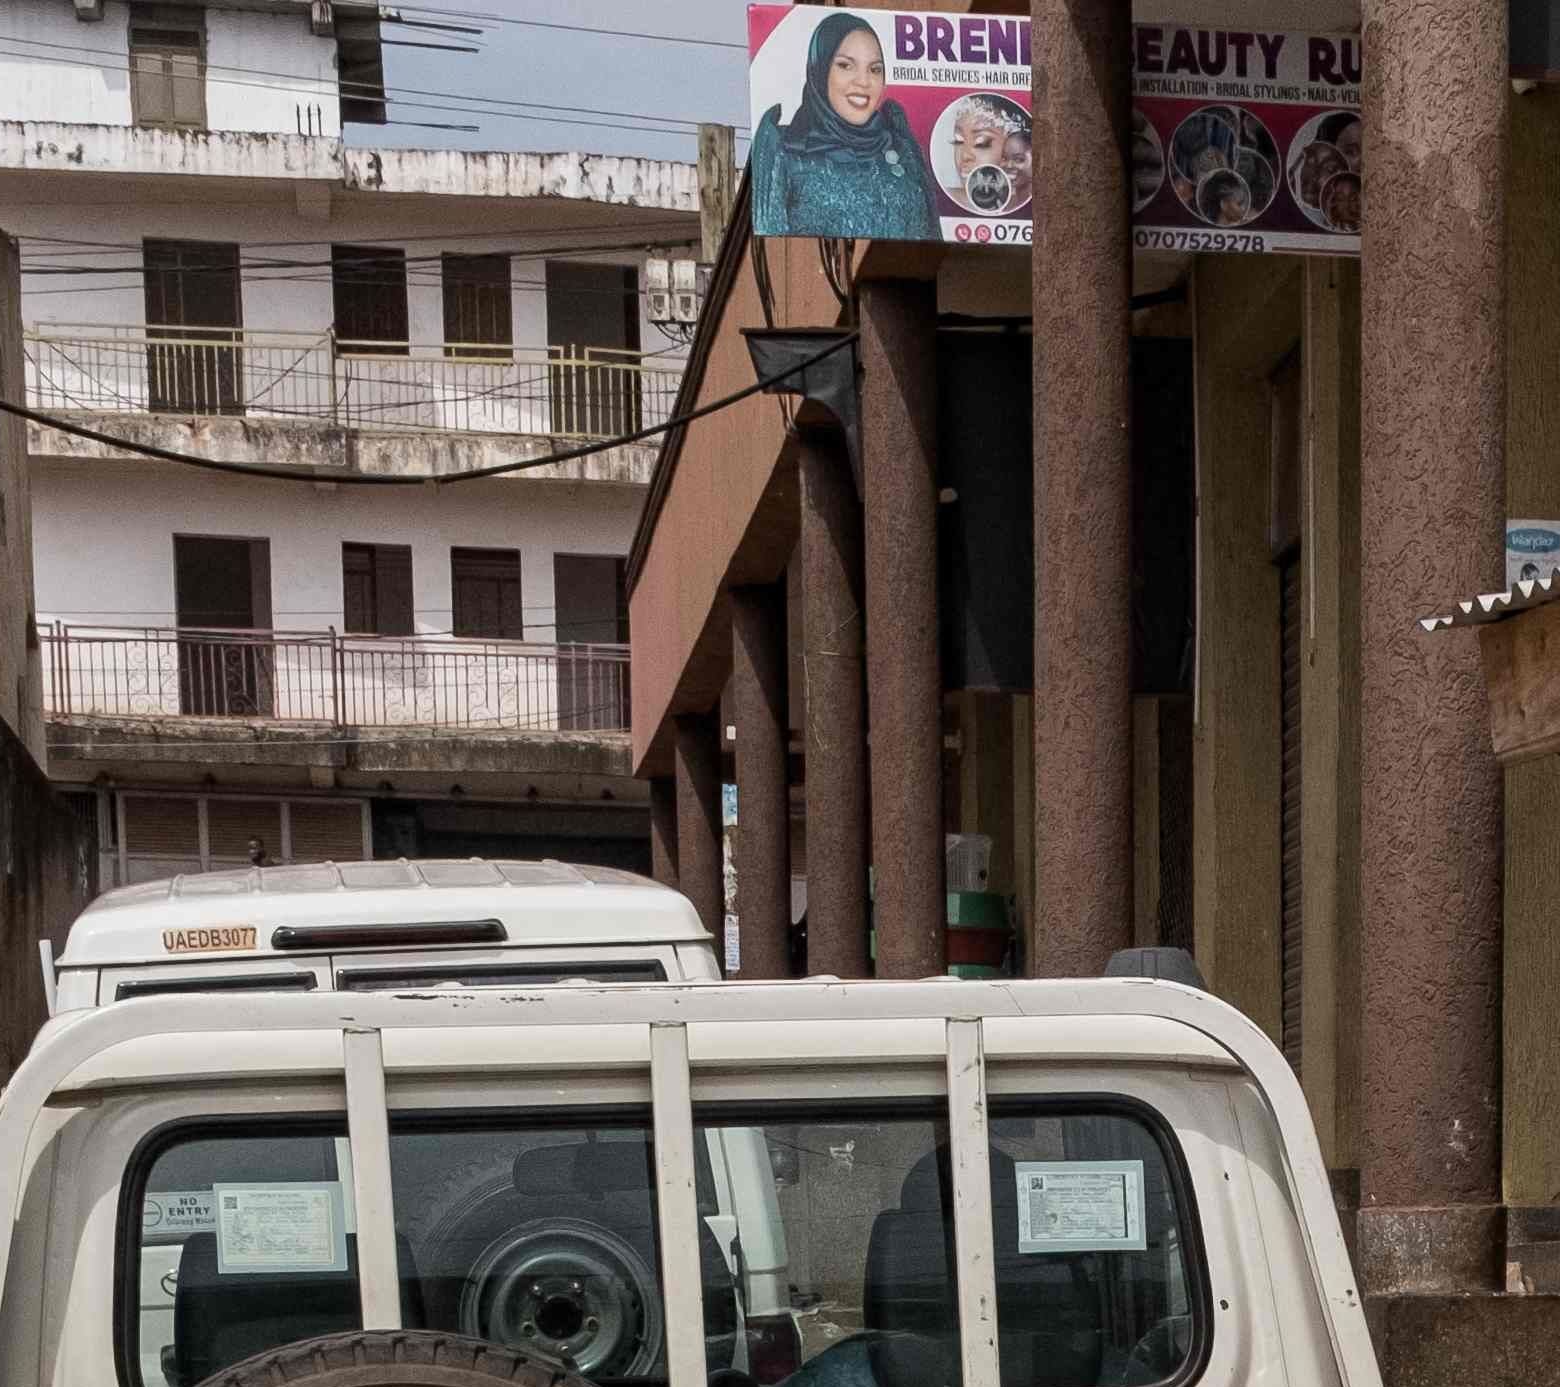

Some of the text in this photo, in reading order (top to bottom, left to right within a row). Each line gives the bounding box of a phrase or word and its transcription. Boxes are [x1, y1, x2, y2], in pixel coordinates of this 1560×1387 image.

[1131, 26, 1285, 80] EAUTY
[893, 66, 929, 82] BRIDAL
[931, 68, 980, 84] SERVICES
[985, 72, 1009, 84] HAIR
[1141, 78, 1209, 96] INSTALLATION
[1215, 83, 1252, 99] BRIDAL
[1253, 84, 1301, 102] STYLINGS
[1307, 87, 1337, 103] NAILS
[1134, 231, 1265, 253] 0707529278
[162, 927, 257, 950] UAEDB3077
[168, 1206, 211, 1216] ENTRY
[179, 1197, 198, 1206] NO
